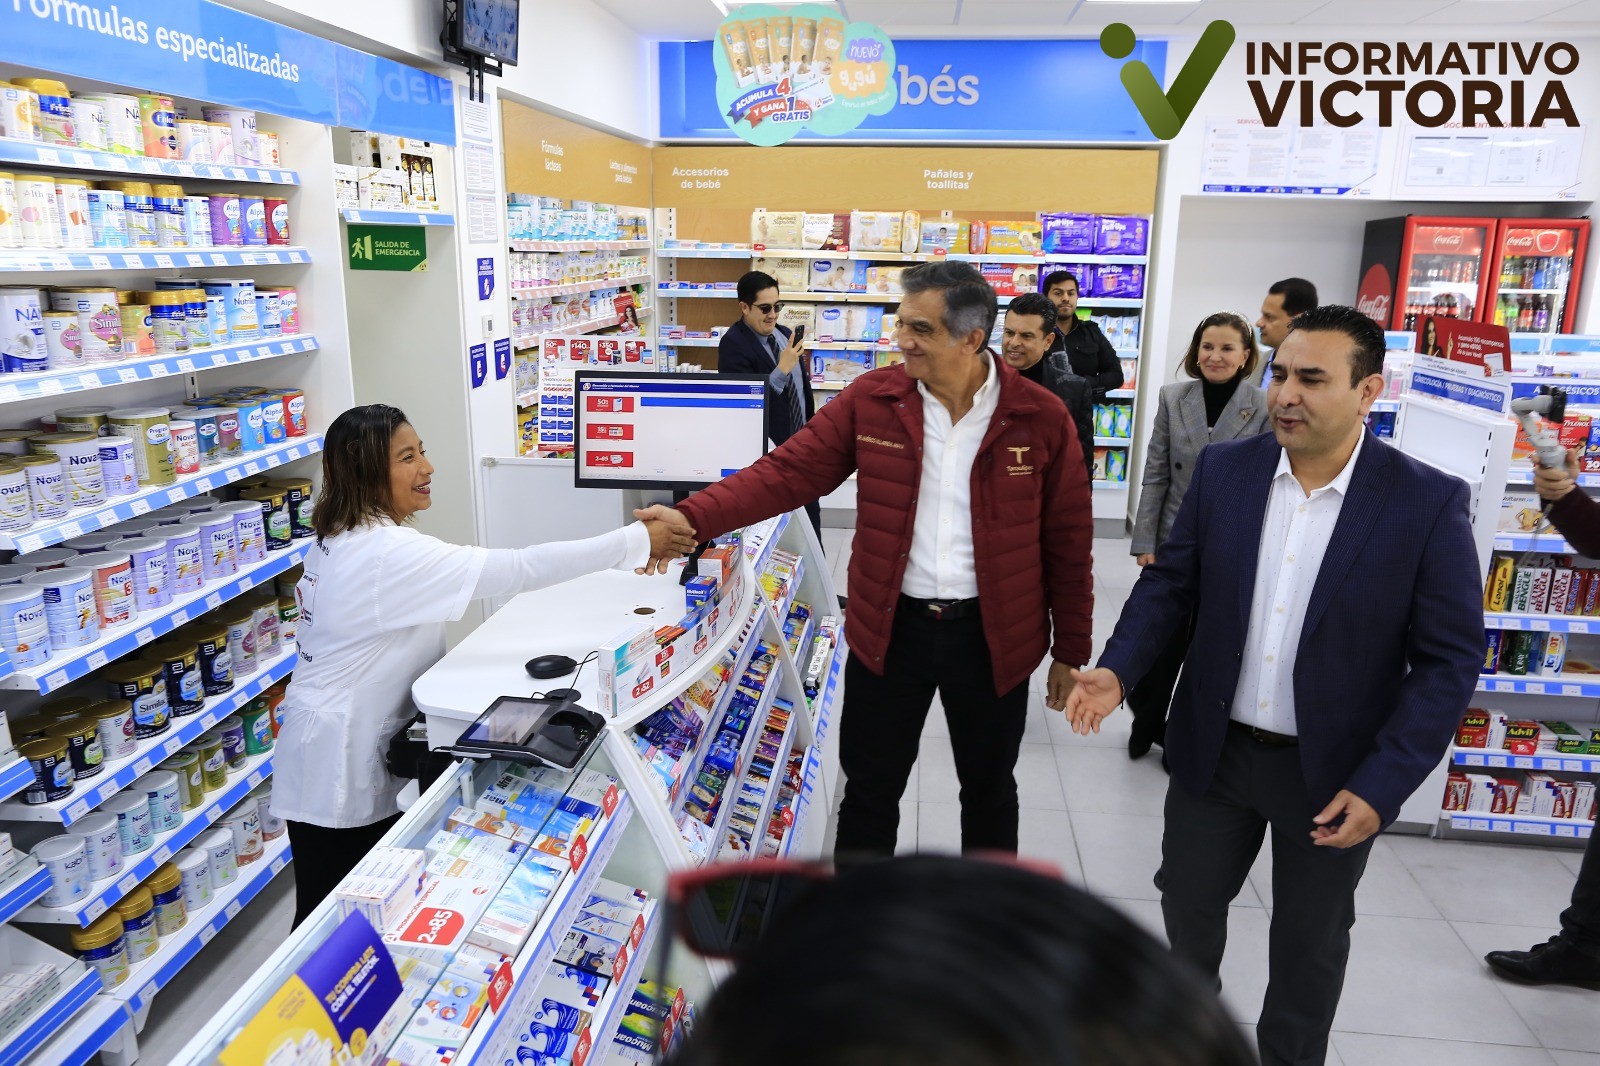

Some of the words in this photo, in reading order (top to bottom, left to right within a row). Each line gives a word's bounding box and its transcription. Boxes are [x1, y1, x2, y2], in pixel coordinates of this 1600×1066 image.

[156, 26, 300, 82] especializadas
[736, 90, 774, 111] ACUMULA
[775, 78, 792, 96] 4
[761, 102, 784, 114] GANA
[772, 110, 810, 122] GRATIS
[542, 140, 564, 157] Fórmulas
[544, 158, 562, 172] lácteas
[672, 166, 729, 178] Accesorios
[924, 169, 964, 180] Pañales
[967, 172, 974, 180] y
[681, 180, 694, 189] de
[696, 178, 720, 189] bebé
[927, 180, 969, 190] toallitas
[1434, 236, 1462, 246] Coca-Cola
[1506, 237, 1533, 247] Coca-Cola
[1414, 376, 1442, 388] GINECOLOGÍA
[1445, 382, 1464, 393] PRUEBAS
[1468, 387, 1502, 402] DIAGNÓSTICO
[1534, 386, 1600, 396] AGÉSICOS
[1493, 579, 1504, 606] Lonol
[1518, 570, 1532, 611] BENGUE
[1530, 578, 1540, 606] ULTRA
[1536, 571, 1550, 612] BENGUE
[1551, 579, 1560, 606] ULTRA
[1555, 572, 1570, 613] BENGUE
[1465, 718, 1485, 726] Advil
[1507, 727, 1534, 736] Advil
[334, 963, 360, 994] COMPRA
